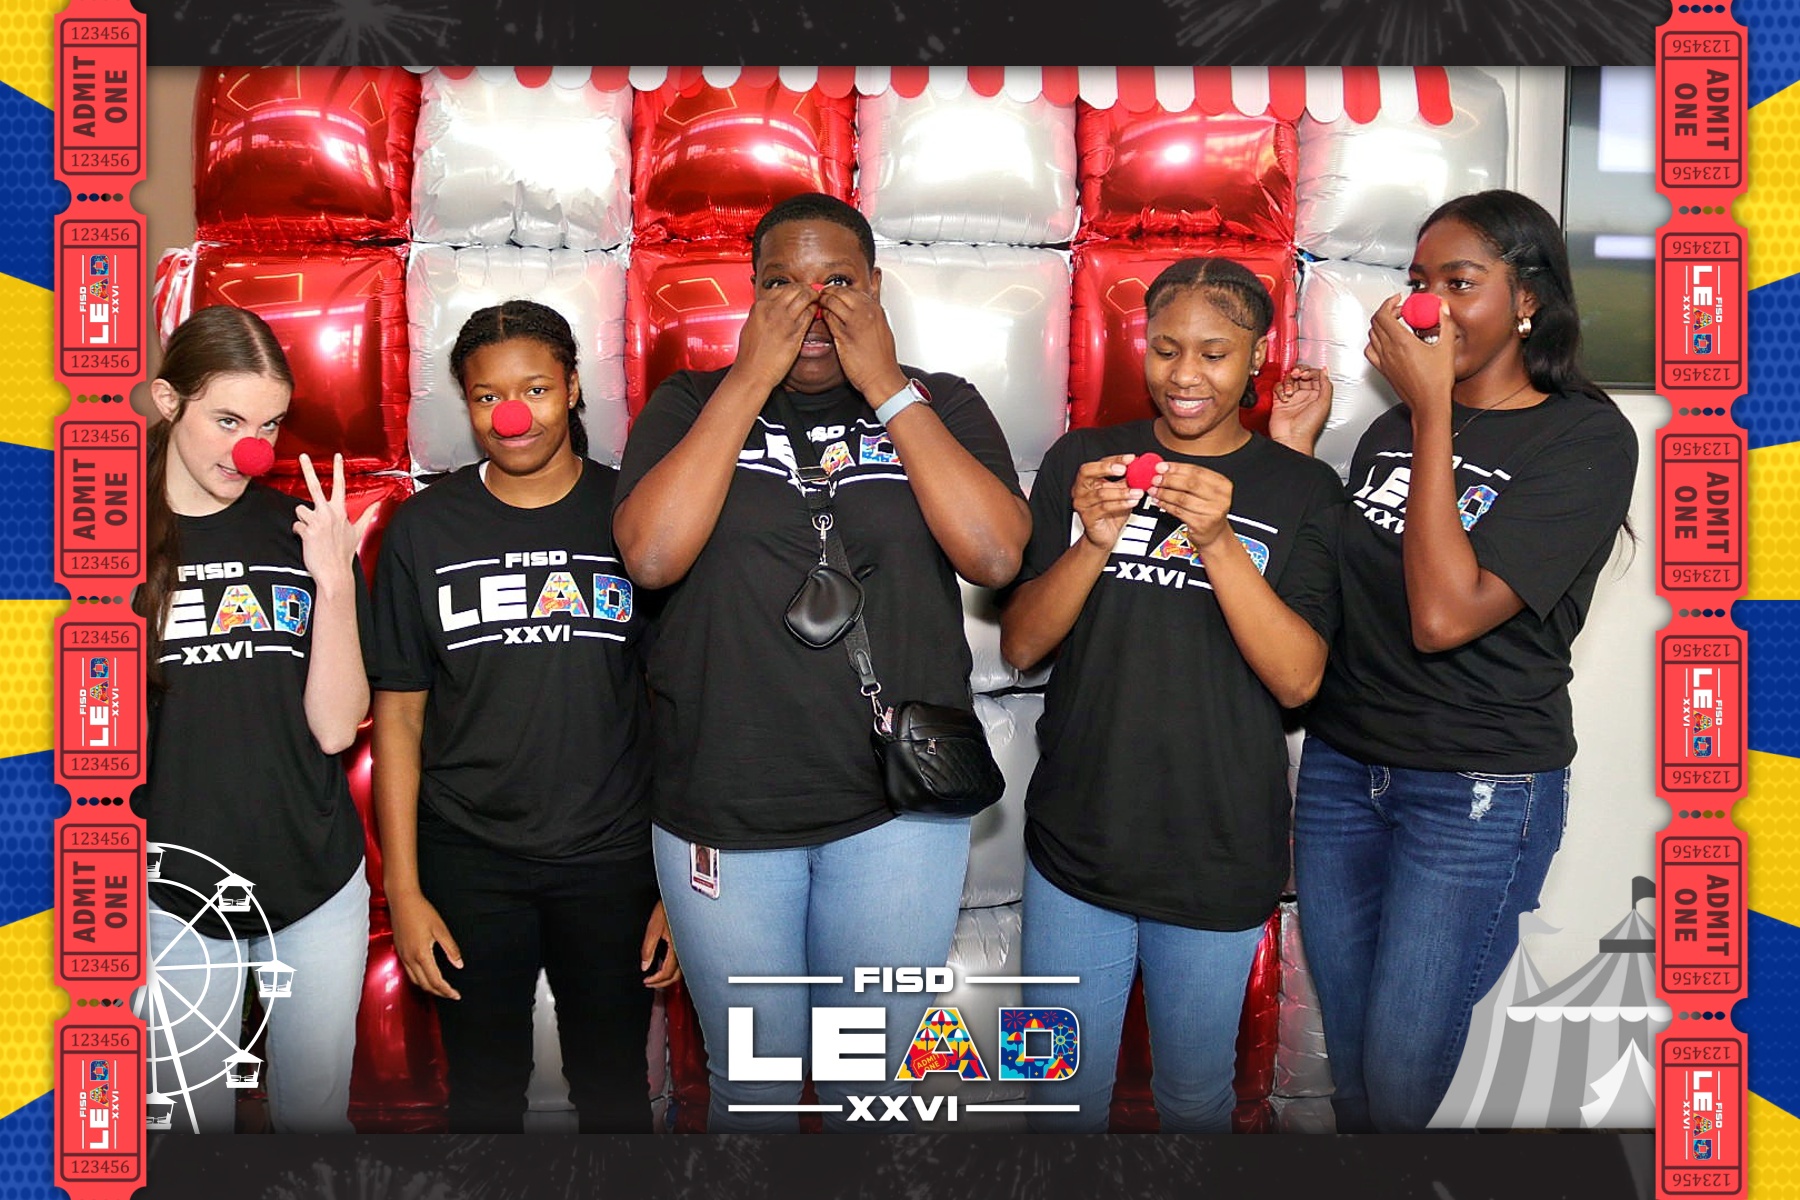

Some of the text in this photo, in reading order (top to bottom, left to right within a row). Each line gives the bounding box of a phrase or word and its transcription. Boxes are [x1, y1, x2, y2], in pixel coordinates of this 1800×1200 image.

[505, 550, 567, 568] FISD
[178, 562, 244, 582] FISD
[1116, 561, 1186, 588] XXVI
[157, 585, 312, 641] EAD
[438, 572, 633, 632] LEAD
[503, 625, 570, 644] XXVI
[181, 641, 253, 665] XXVI
